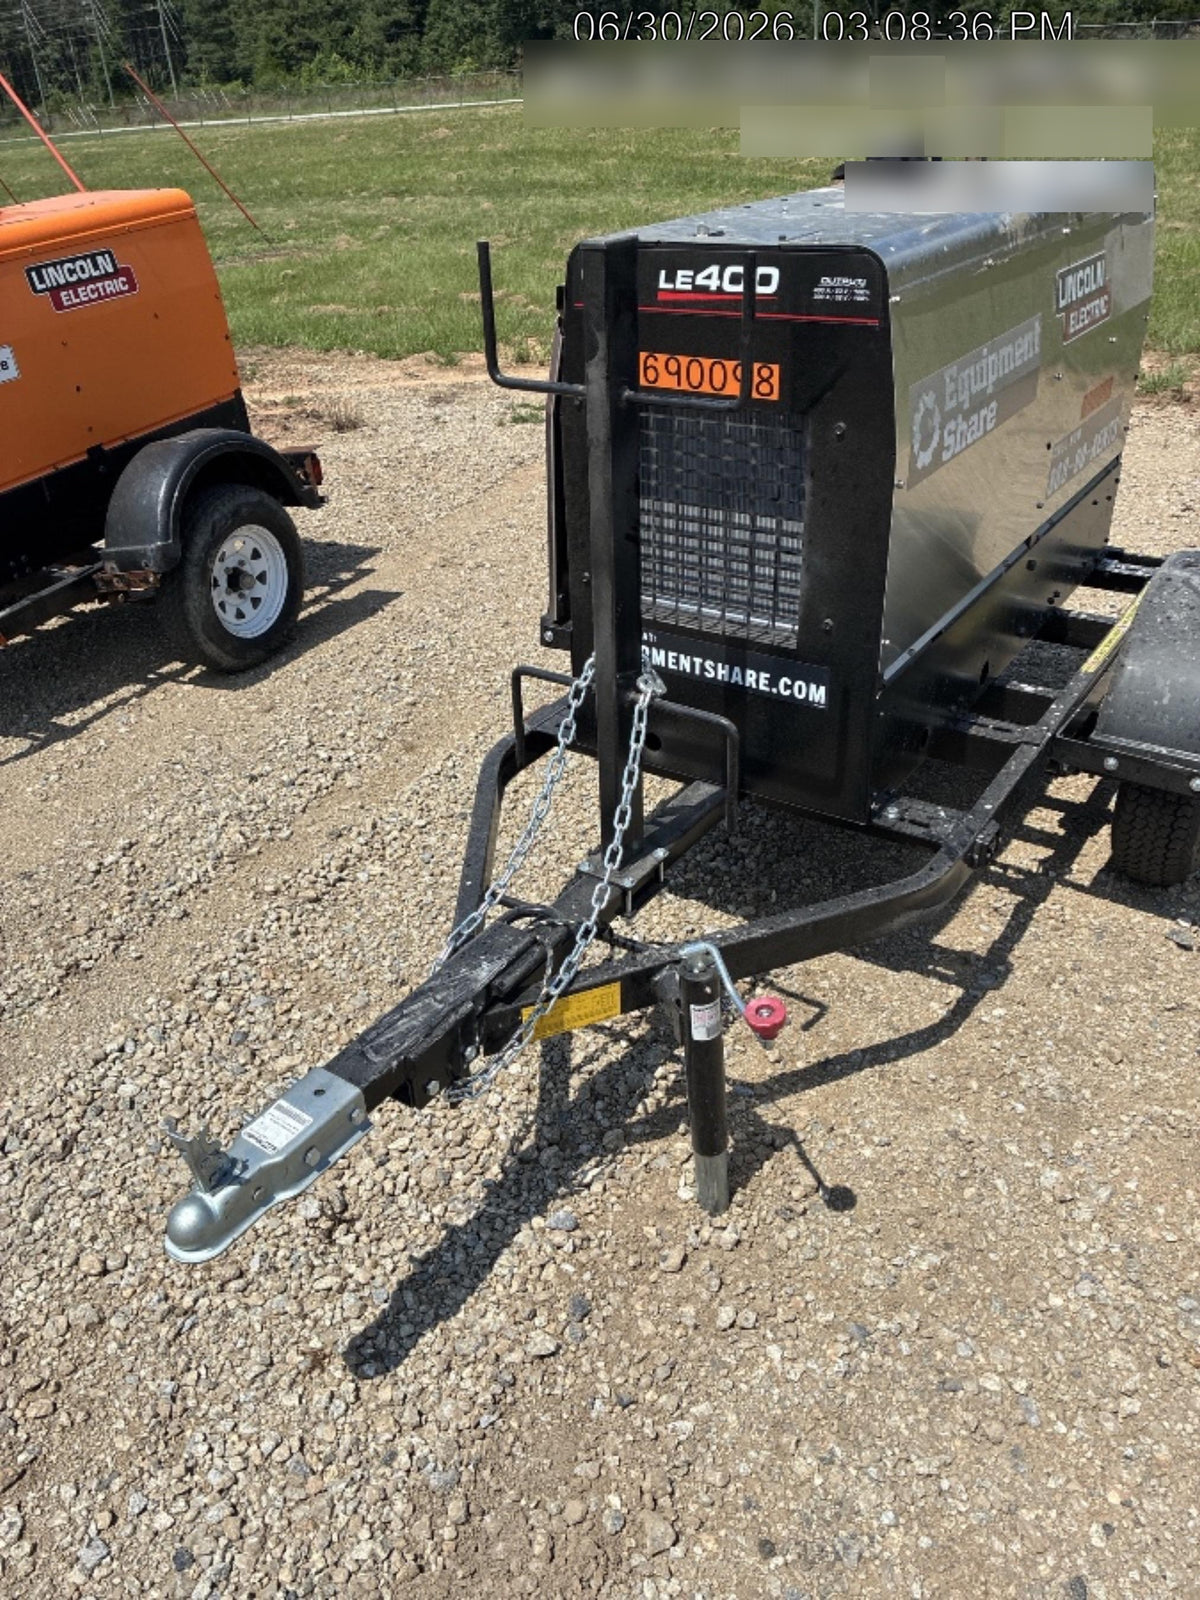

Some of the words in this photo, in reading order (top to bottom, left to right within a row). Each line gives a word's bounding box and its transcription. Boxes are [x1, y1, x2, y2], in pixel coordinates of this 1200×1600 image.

[31, 254, 114, 290] LINCOLN
[60, 277, 129, 306] ELECTRIC
[658, 264, 780, 294] LE400
[1059, 259, 1105, 308] LINCOLN
[1069, 294, 1109, 333] ELECTRIC
[943, 319, 1041, 412] Equipment
[942, 399, 998, 462] Share
